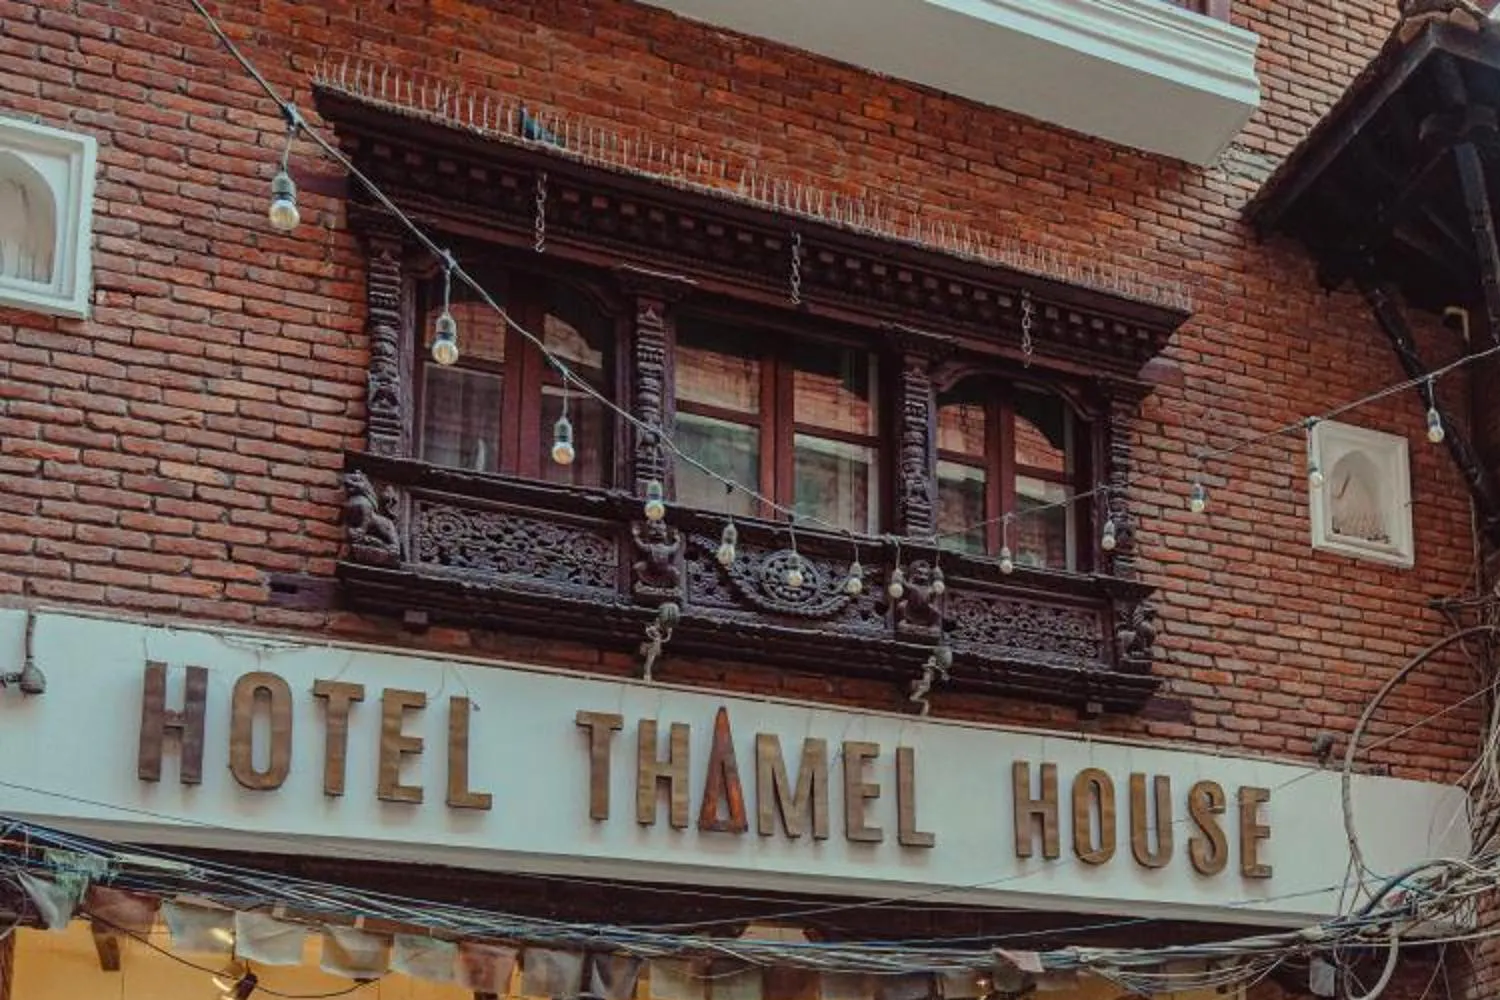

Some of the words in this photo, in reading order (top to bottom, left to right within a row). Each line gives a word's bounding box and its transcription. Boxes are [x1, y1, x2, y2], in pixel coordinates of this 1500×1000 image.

[137, 660, 493, 811] HOTEL
[575, 705, 936, 848] THAMEL
[1012, 760, 1273, 879] HOUSE
